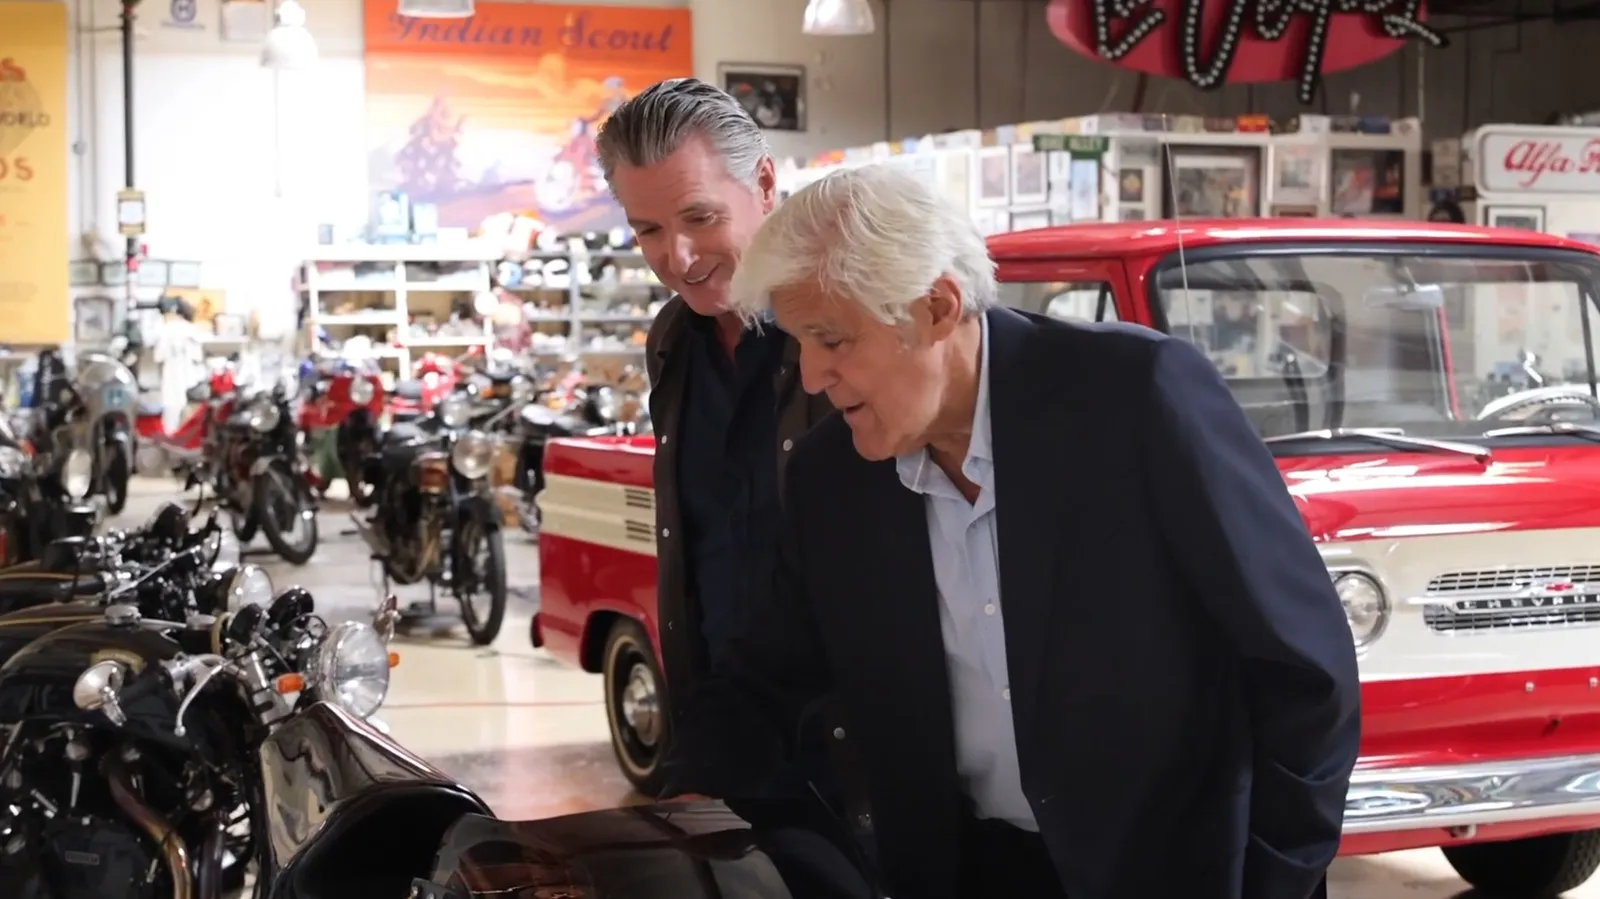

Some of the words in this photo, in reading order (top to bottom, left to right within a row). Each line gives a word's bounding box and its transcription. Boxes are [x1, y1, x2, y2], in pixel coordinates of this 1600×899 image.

[389, 13, 543, 45] Indian
[558, 11, 674, 51] Scout
[1504, 139, 1574, 188] Alfa
